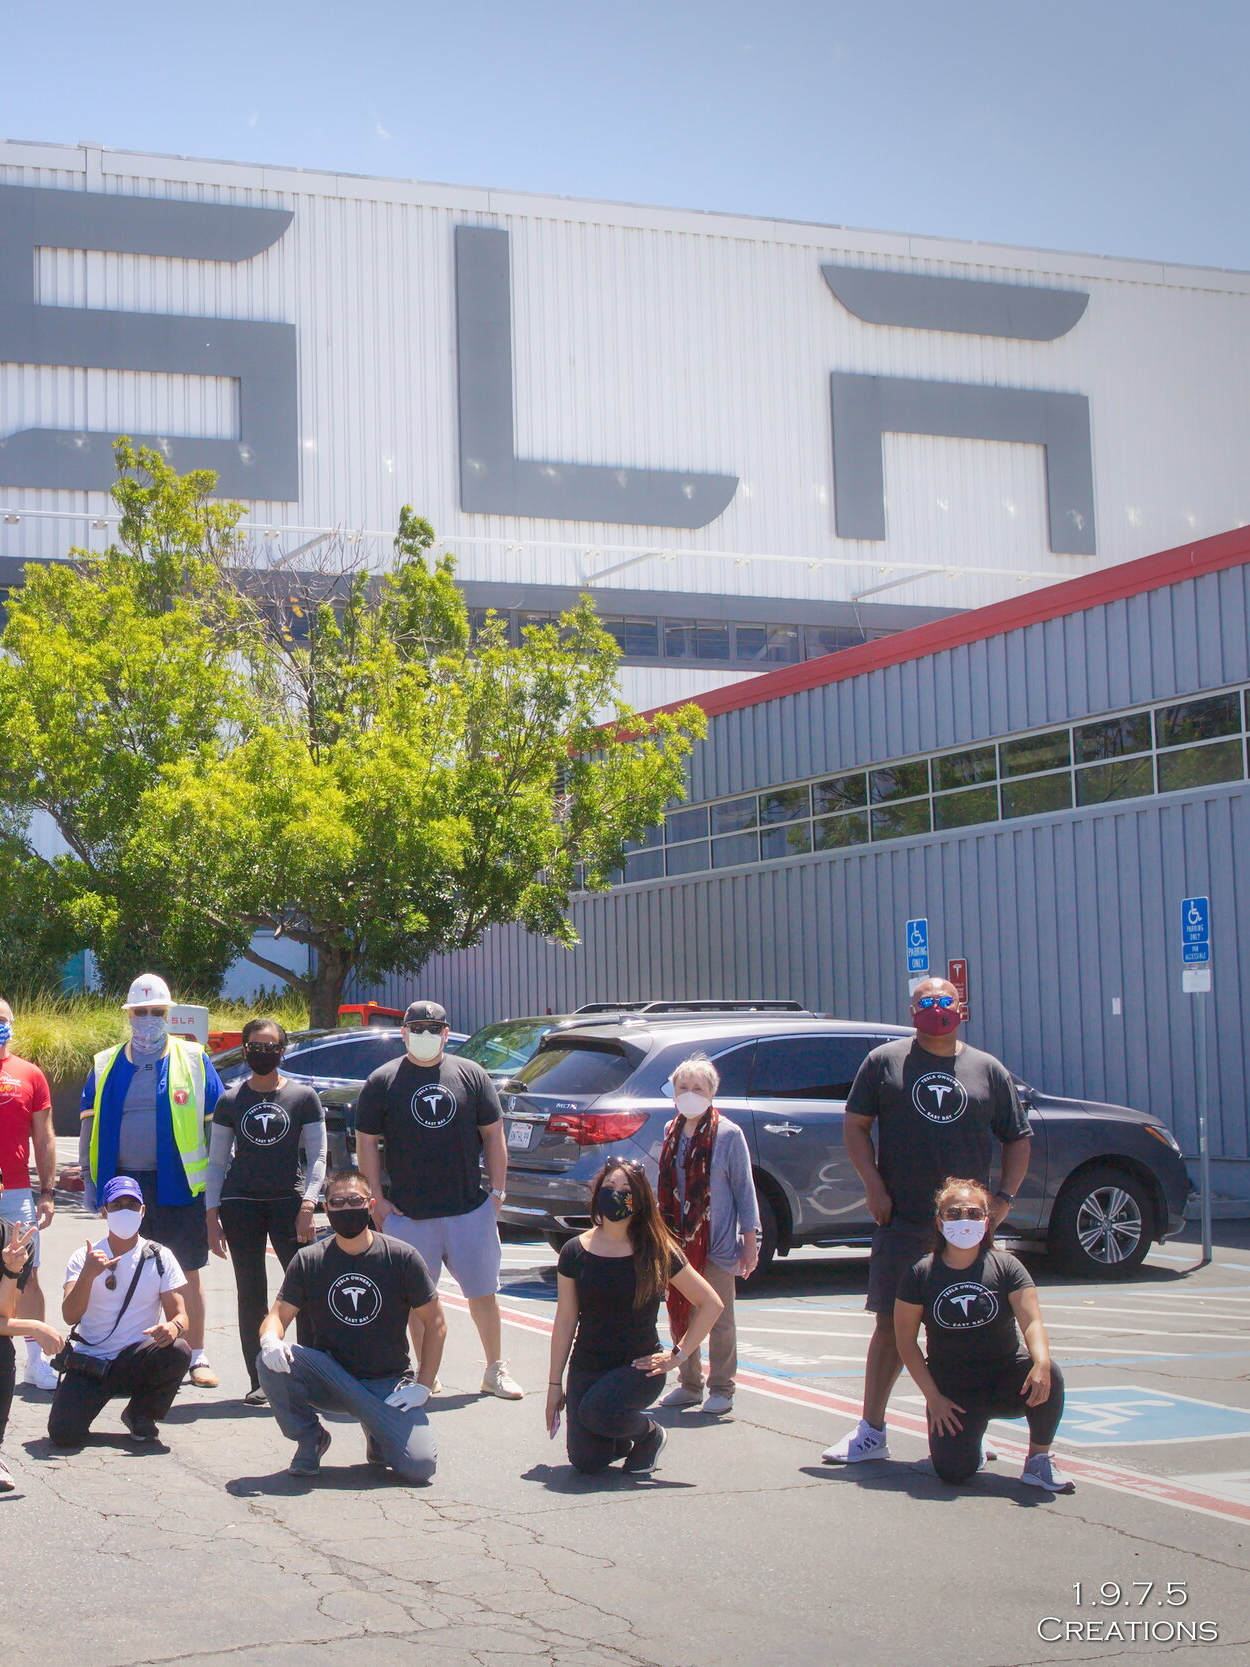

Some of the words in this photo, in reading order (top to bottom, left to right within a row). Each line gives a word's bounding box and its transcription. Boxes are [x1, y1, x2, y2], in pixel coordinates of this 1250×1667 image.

[908, 946, 926, 957] PARKING
[912, 958, 924, 969] ONLY
[937, 1074, 959, 1087] OWNERS
[350, 1276, 372, 1288] OWNERS
